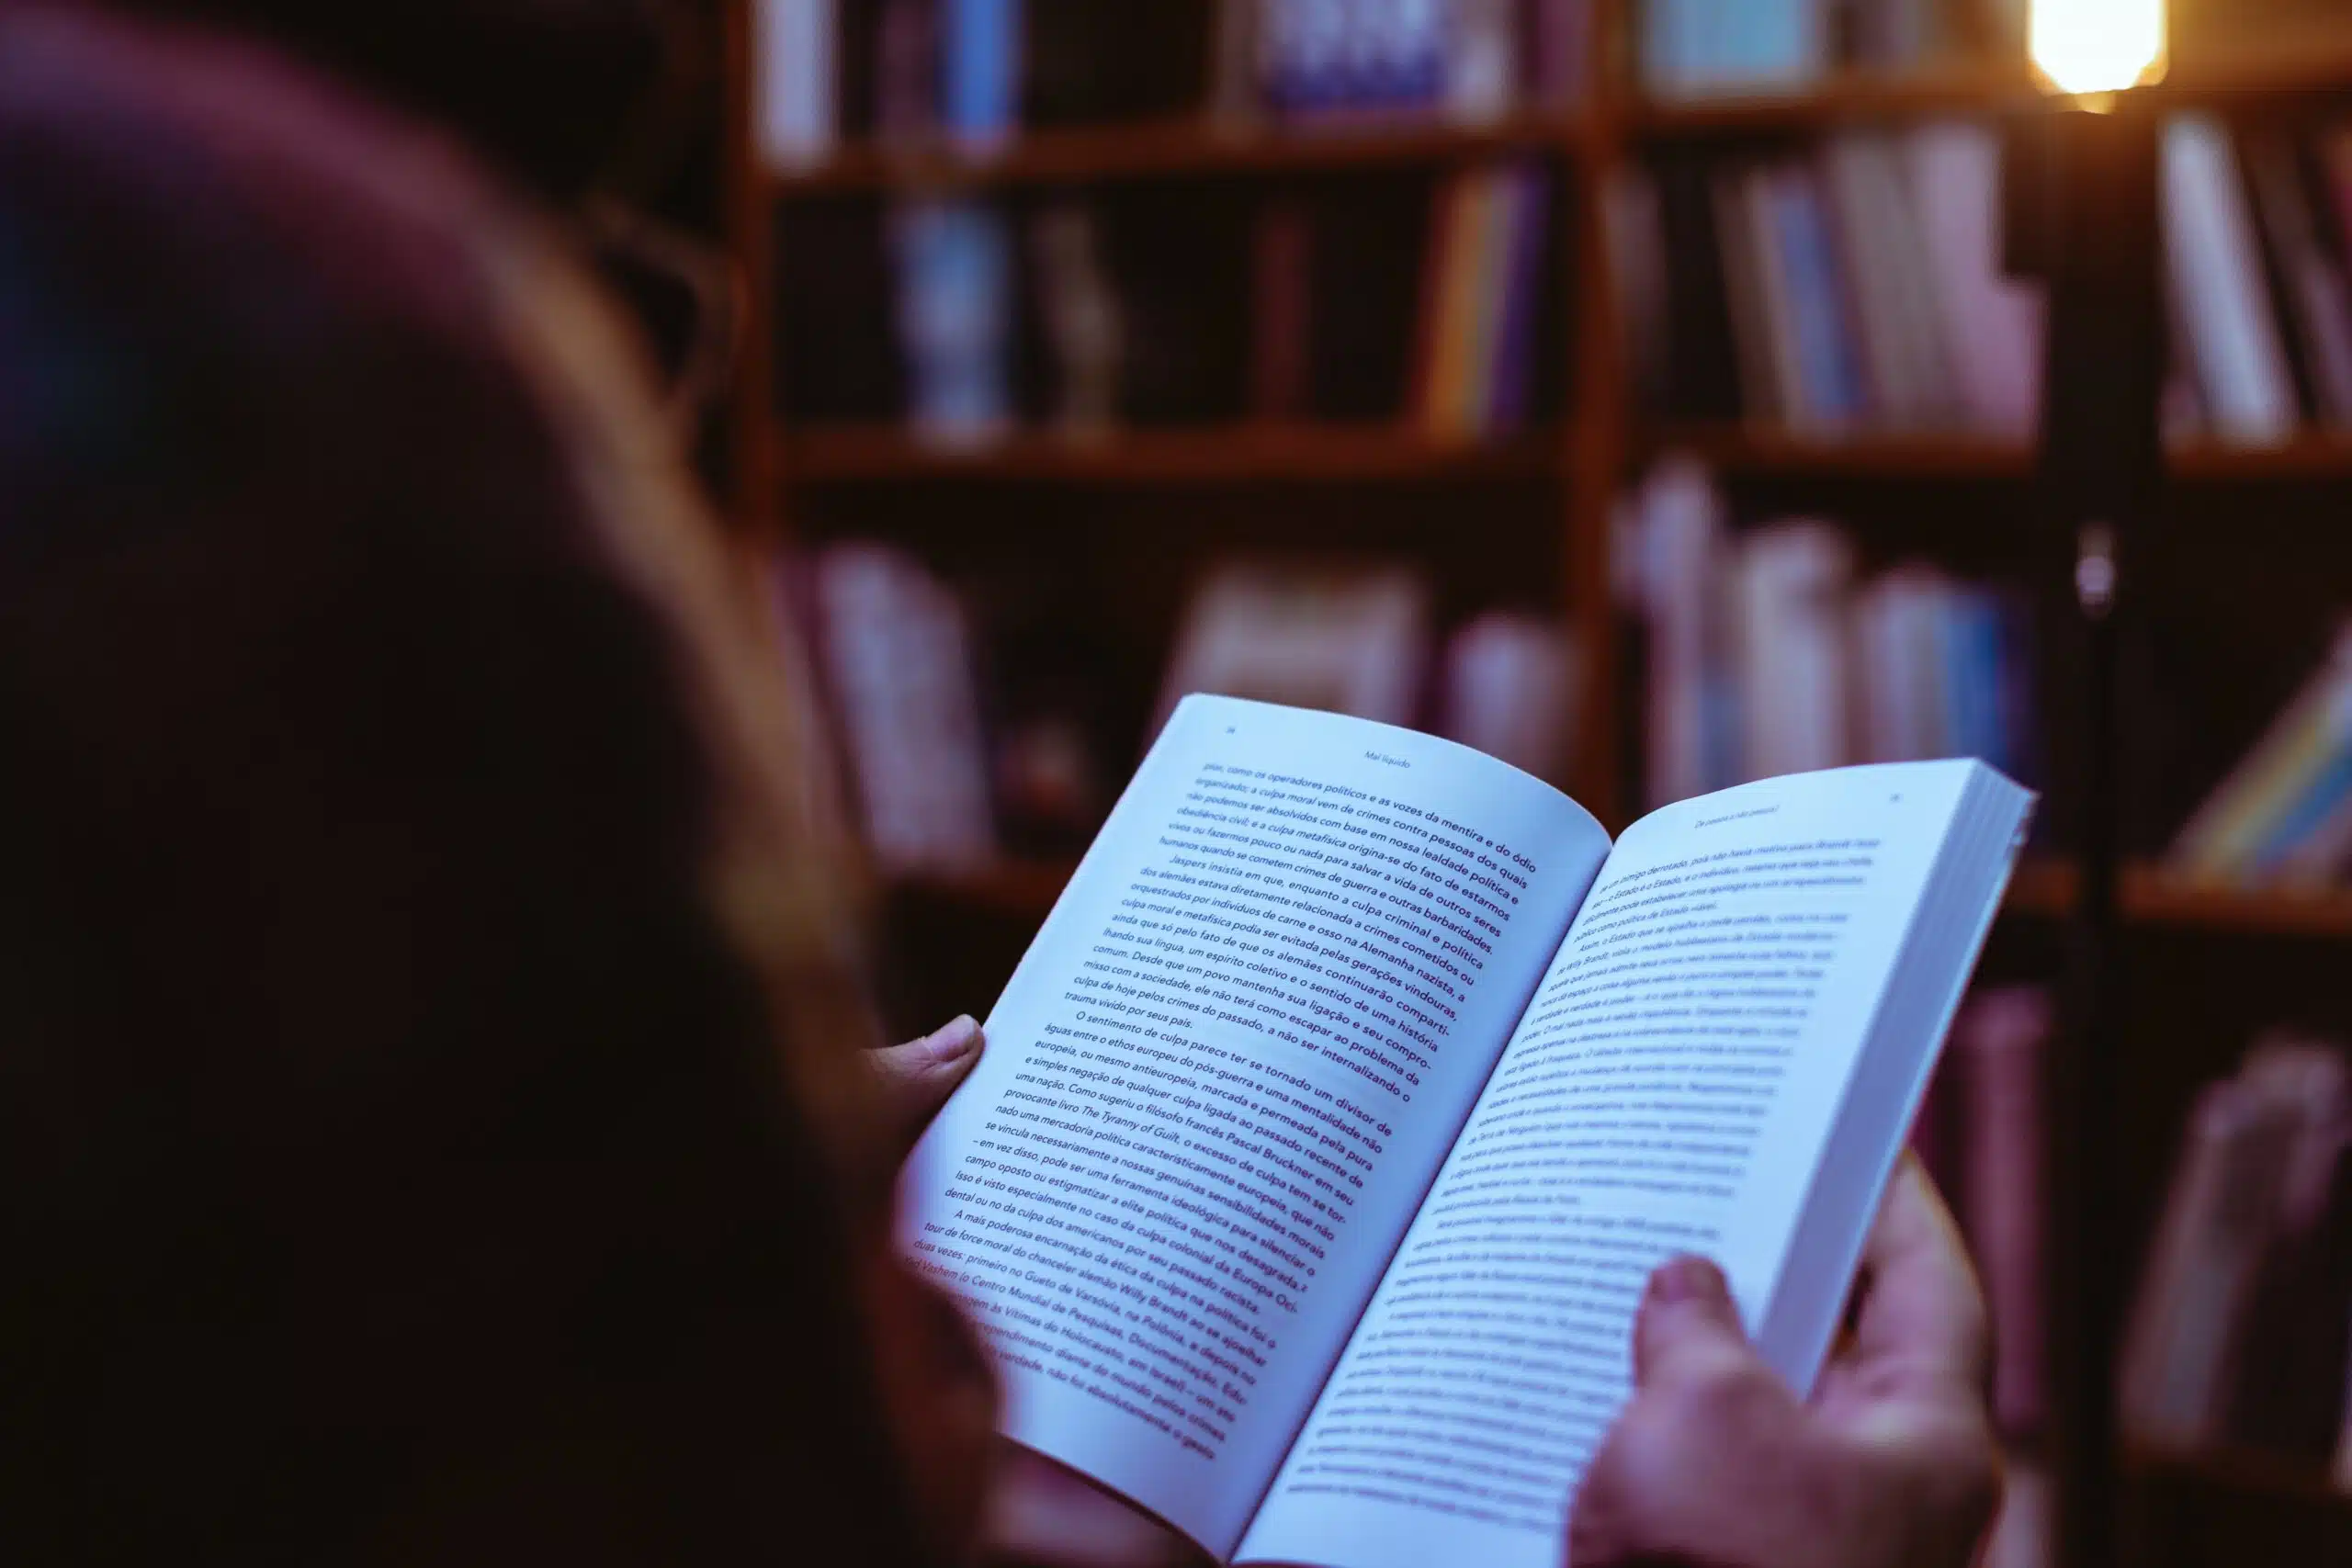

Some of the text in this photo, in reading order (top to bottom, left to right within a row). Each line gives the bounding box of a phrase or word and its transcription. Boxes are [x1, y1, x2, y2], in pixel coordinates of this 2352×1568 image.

[1159, 836, 1199, 850] humanos
[1200, 845, 1235, 857] quando
[1248, 855, 1293, 869] cometem
[1294, 865, 1327, 878] crimes
[1328, 873, 1341, 883] de
[1341, 879, 1377, 895] guerra
[1388, 895, 1422, 913] outras
[1266, 807, 1317, 823] absolvidos
[1319, 818, 1340, 828] com
[1342, 821, 1367, 835] base
[1369, 831, 1386, 841] em
[1388, 838, 1419, 852] nossa
[1421, 847, 1468, 874] lealdade
[1468, 872, 1510, 898] política
[1267, 773, 1322, 789] operadores
[1323, 784, 1367, 799] políticos
[1377, 797, 1390, 806] as
[1393, 801, 1422, 816] vozes
[1424, 811, 1439, 822] da
[1441, 819, 1484, 842] mentira
[1495, 843, 1510, 856] do
[1512, 852, 1535, 873] ódio
[1121, 898, 1146, 908] culpa
[1147, 904, 1175, 914] moral
[1182, 911, 1231, 927] metafísica
[1230, 922, 1261, 934] podia
[1262, 930, 1279, 938] ser
[1280, 934, 1318, 952] evitada
[1318, 948, 1350, 963] pelas
[1350, 959, 1402, 987] gerações
[1405, 983, 1456, 1021] vindouras,
[1139, 866, 1157, 876] dos
[1158, 870, 1196, 884] alemães
[1197, 879, 1228, 890] estava
[1230, 885, 1290, 905] diretamente
[1292, 900, 1352, 924] relacionada
[1363, 924, 1399, 943] crimes
[1401, 941, 1458, 975] cometidos
[1460, 973, 1474, 985] ou
[1064, 991, 1192, 1028] trauma vivido por seus pais.
[1083, 961, 1110, 971] misso
[1111, 966, 1131, 976] com
[1140, 973, 1191, 991] sociedade,
[1194, 985, 1210, 995] ele
[1212, 990, 1231, 1000] não
[1233, 995, 1255, 1008] terá
[1256, 1004, 1286, 1018] como
[1288, 1015, 1332, 1036] escapar
[1333, 1033, 1349, 1044] ao
[1348, 1042, 1404, 1075] problema
[1405, 1072, 1419, 1085] da
[1102, 927, 1135, 941] lhando
[1136, 936, 1152, 944] sua
[1154, 938, 1183, 953] língua,
[1188, 948, 1204, 956] um
[1205, 952, 1244, 966] espírito
[1246, 963, 1287, 979] coletivo
[1309, 983, 1351, 1004] sentido
[1353, 999, 1369, 1011] de
[1371, 1009, 1396, 1025] uma
[1397, 1020, 1437, 1052] história
[1035, 1040, 1076, 1056] europeia,
[1094, 1055, 1130, 1068] mesmo
[1132, 1064, 1197, 1089] antieuropeia,
[1201, 1084, 1248, 1106] marcada
[1259, 1106, 1317, 1138] permeada
[1318, 1134, 1345, 1153] pela
[1345, 1150, 1372, 1170] pura
[1076, 1010, 1391, 1136] O sentimento de culpa parece ter se tornado um divisor de
[985, 1122, 996, 1130] se
[998, 1123, 1029, 1138] vincula
[1030, 1134, 1110, 1160] necessariamente
[1120, 1158, 1154, 1175] nossas
[1155, 1171, 1205, 1194] genuínas
[1206, 1190, 1285, 1235] sensibilidades
[1287, 1231, 1324, 1258] morais
[995, 1105, 1018, 1116] nado
[1019, 1111, 1039, 1121] uma
[1040, 1117, 1093, 1135] mercadoria
[1092, 1131, 1131, 1146] política
[1132, 1142, 1235, 1186] caracteristicamente
[1291, 1210, 1312, 1226] que
[1015, 1074, 1035, 1082] uma
[1035, 1077, 1065, 1089] nação.
[1068, 1083, 1097, 1098] Como
[1098, 1093, 1135, 1108] sugeriu
[1145, 1103, 1182, 1122] filósofo
[1185, 1116, 1224, 1138] francês
[1225, 1132, 1262, 1154] Pascal
[1262, 1147, 1314, 1179] Bruckner
[1315, 1178, 1333, 1192] em
[1333, 1190, 1353, 1205] seu
[955, 1170, 973, 1181] Isso
[975, 1175, 982, 1184] é
[983, 1178, 1005, 1190] visto
[1007, 1186, 1077, 1211] especialmente
[1078, 1207, 1092, 1216] no
[1093, 1212, 1118, 1224] caso
[1120, 1220, 1135, 1231] da
[1136, 1227, 1166, 1244] culpa
[1168, 1240, 1215, 1264] colonial
[1215, 1259, 1229, 1273] da
